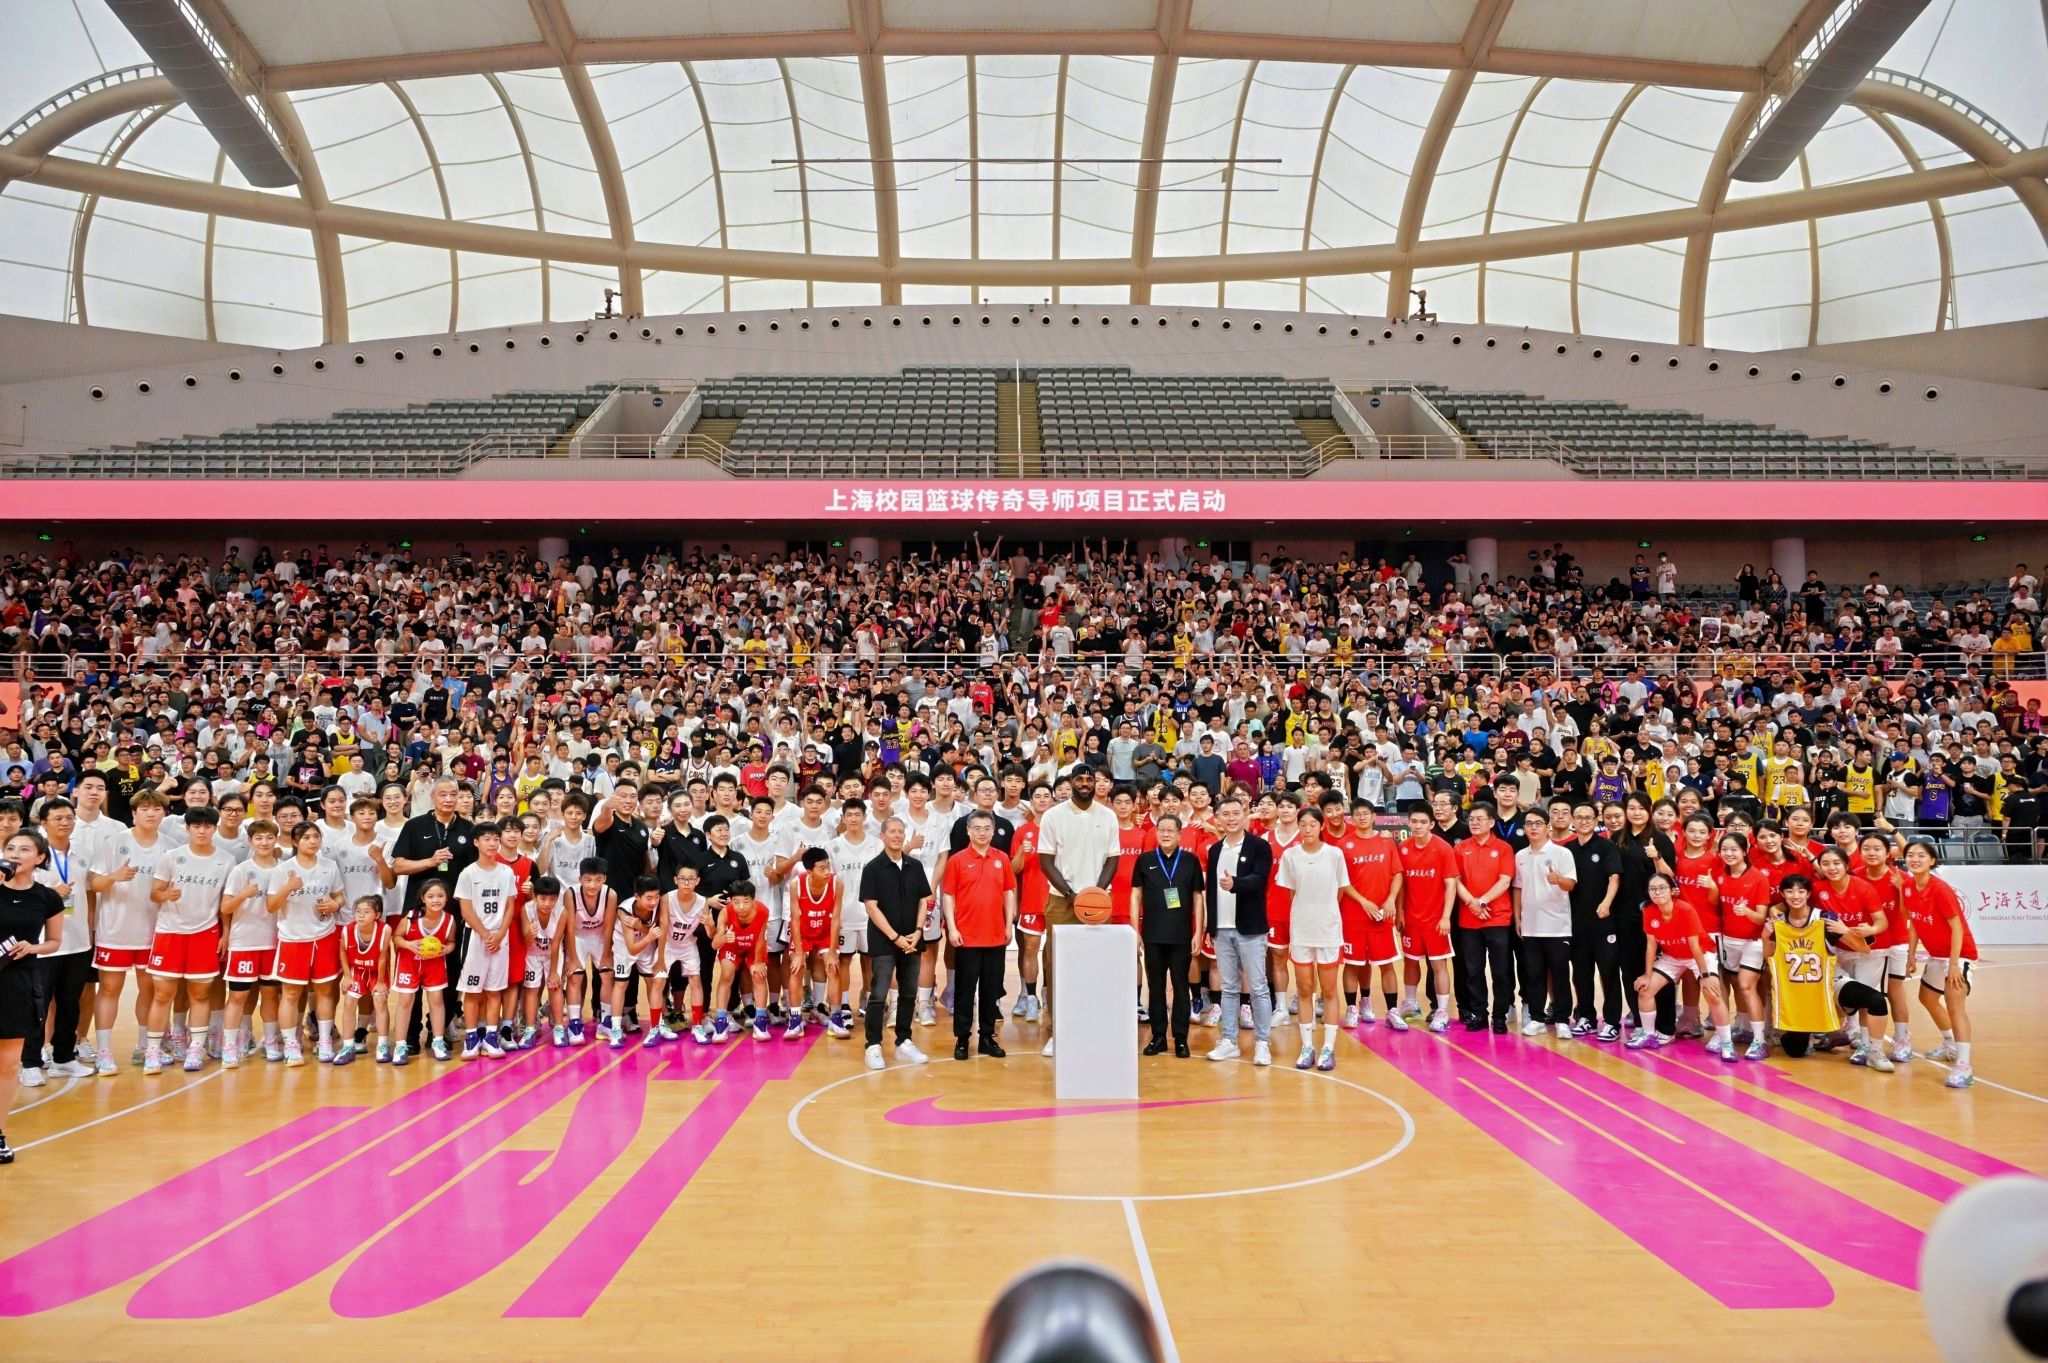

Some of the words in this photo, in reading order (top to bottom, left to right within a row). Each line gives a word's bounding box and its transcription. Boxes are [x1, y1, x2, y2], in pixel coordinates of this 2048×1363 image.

[824, 488, 1226, 513] 上海校园篮球传奇导师项目正式启动
[643, 742, 655, 751] 23
[1786, 796, 1798, 805] 23
[484, 902, 498, 914] 89
[672, 931, 686, 941] 87
[1787, 938, 1815, 951] JAMES
[237, 960, 254, 974] 80
[616, 964, 625, 974] 91
[1784, 952, 1824, 983] 23
[398, 973, 412, 985] 95
[467, 975, 480, 986] 89
